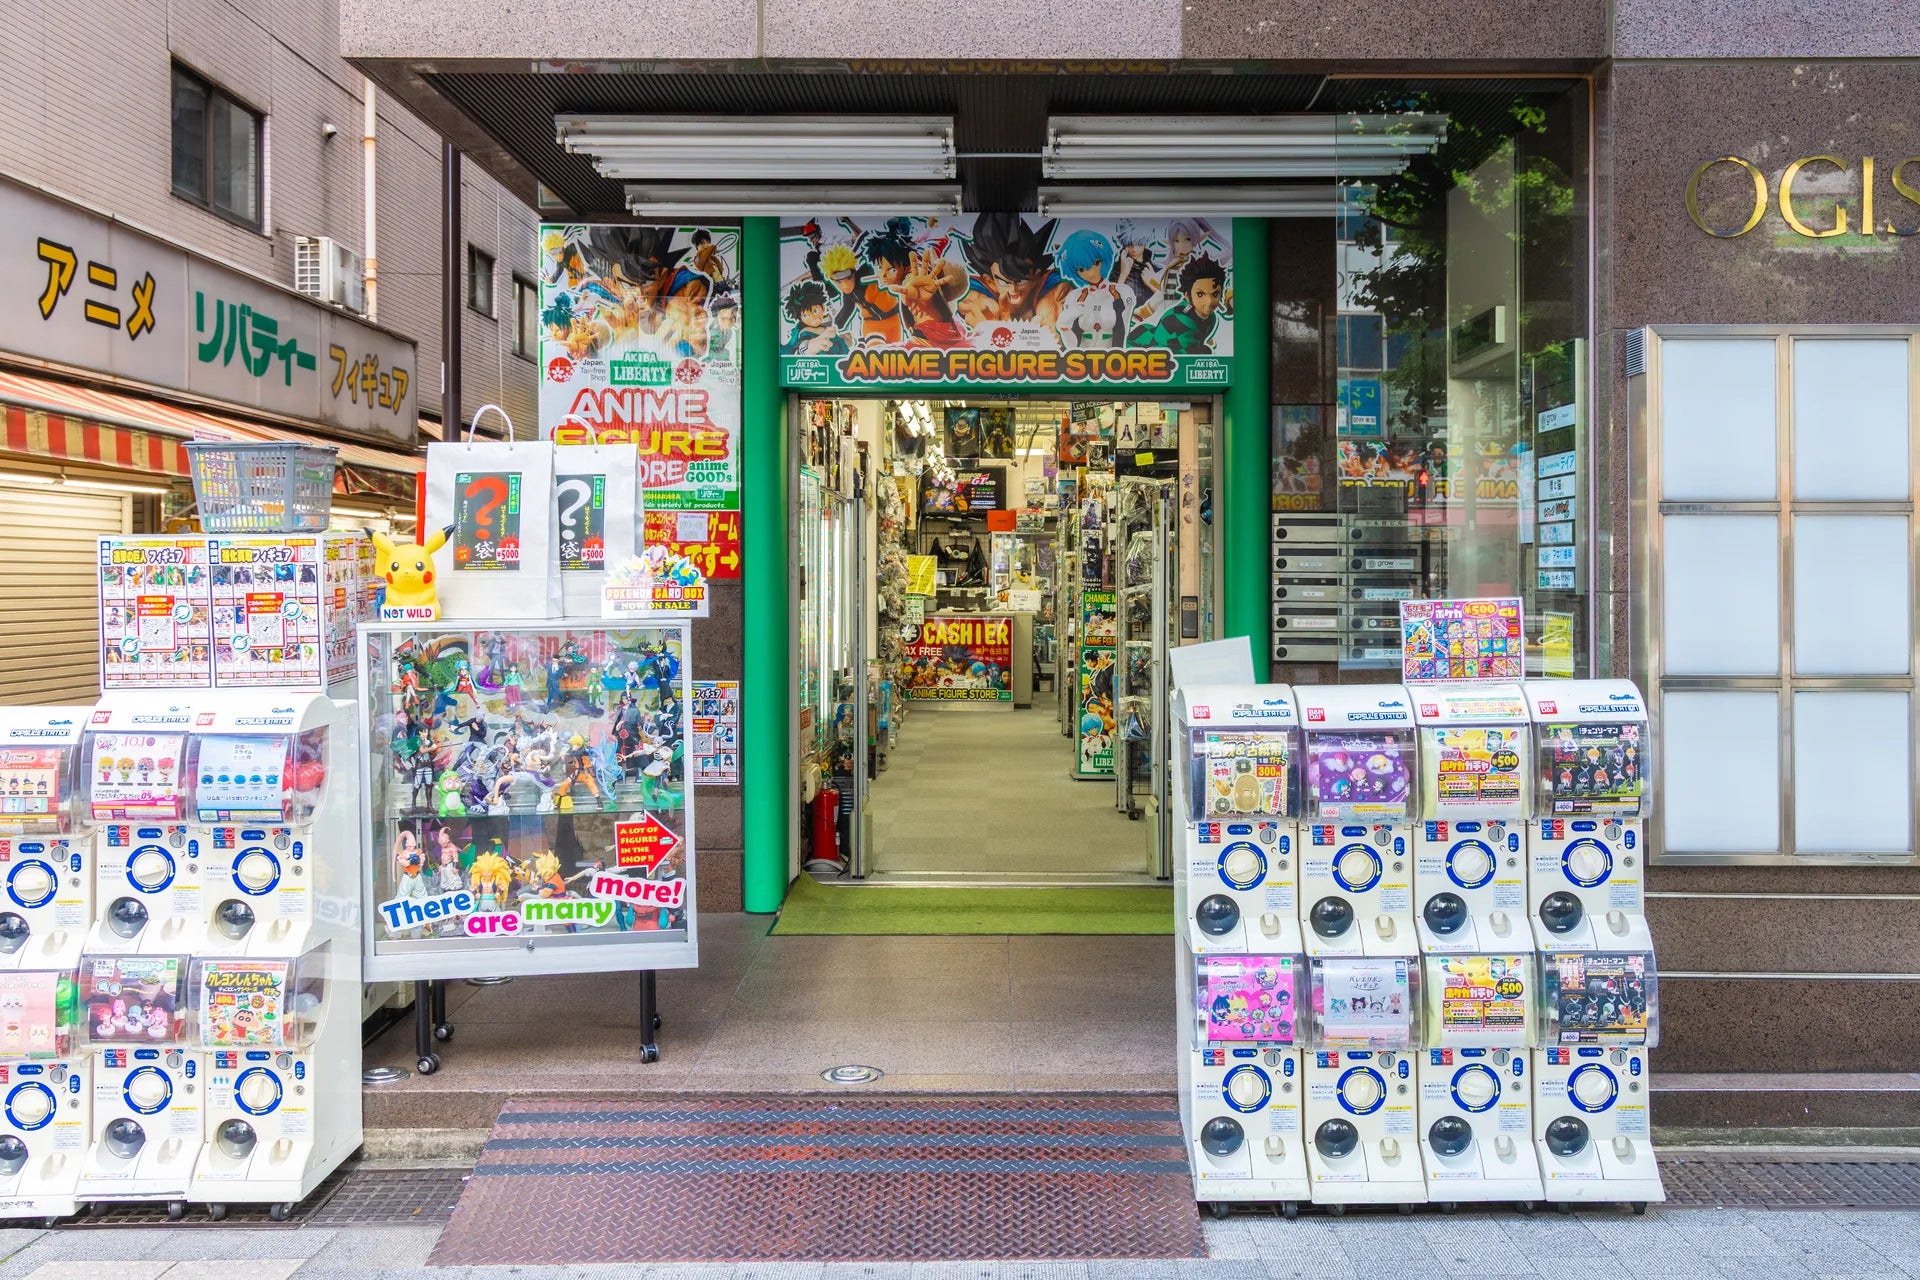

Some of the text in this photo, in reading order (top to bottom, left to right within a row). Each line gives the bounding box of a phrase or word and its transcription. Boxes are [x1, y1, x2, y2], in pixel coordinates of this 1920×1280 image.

[37, 237, 410, 415] アニメ リバティー フィギュア
[624, 352, 656, 363] AKIBA
[581, 367, 606, 375] Tax-free
[846, 353, 1169, 377] ANIME FIGURE STORE
[590, 374, 607, 382] Shop
[613, 366, 669, 382] LIBERTY
[789, 368, 826, 381] リバティー
[1189, 369, 1225, 380] LIBERTY
[570, 390, 707, 425] ANIME
[1073, 402, 1086, 411] LEVI
[689, 459, 729, 471] anime
[639, 460, 684, 484] ORE
[685, 471, 733, 483] GOODs
[657, 502, 682, 510] variety
[708, 512, 738, 541] ゲーム
[148, 548, 184, 564] フィギュア
[474, 541, 495, 559] 袋
[560, 541, 580, 559] 袋
[605, 587, 704, 600] POKEMON CARD BOX
[1084, 593, 1111, 603] CHANGE
[621, 601, 691, 610] NOW ON SALE
[1405, 604, 1433, 612] ポケモン
[1464, 604, 1496, 615] ¥500
[383, 608, 432, 618] NOT WILD
[1435, 609, 1463, 619] ポケカ
[1498, 607, 1517, 617] くじ
[923, 621, 1009, 645] CASHIER
[904, 647, 943, 656] AX FREE
[692, 688, 722, 699] フィギュア
[911, 688, 998, 699] ANIME FIGURE STORE
[1095, 757, 1113, 766] LIBE
[1440, 760, 1489, 773] ポケカガチャ
[1492, 755, 1518, 767] ¥500
[620, 836, 658, 844] FIGURES
[595, 875, 683, 905] more!
[382, 892, 471, 929] There
[525, 901, 614, 927] many
[467, 913, 519, 934] are
[1586, 957, 1624, 965] チェンソーマン
[207, 972, 273, 986] クレヨンしんちゃん
[1445, 986, 1494, 999] ポケカガチャ
[1496, 982, 1523, 994] ¥500
